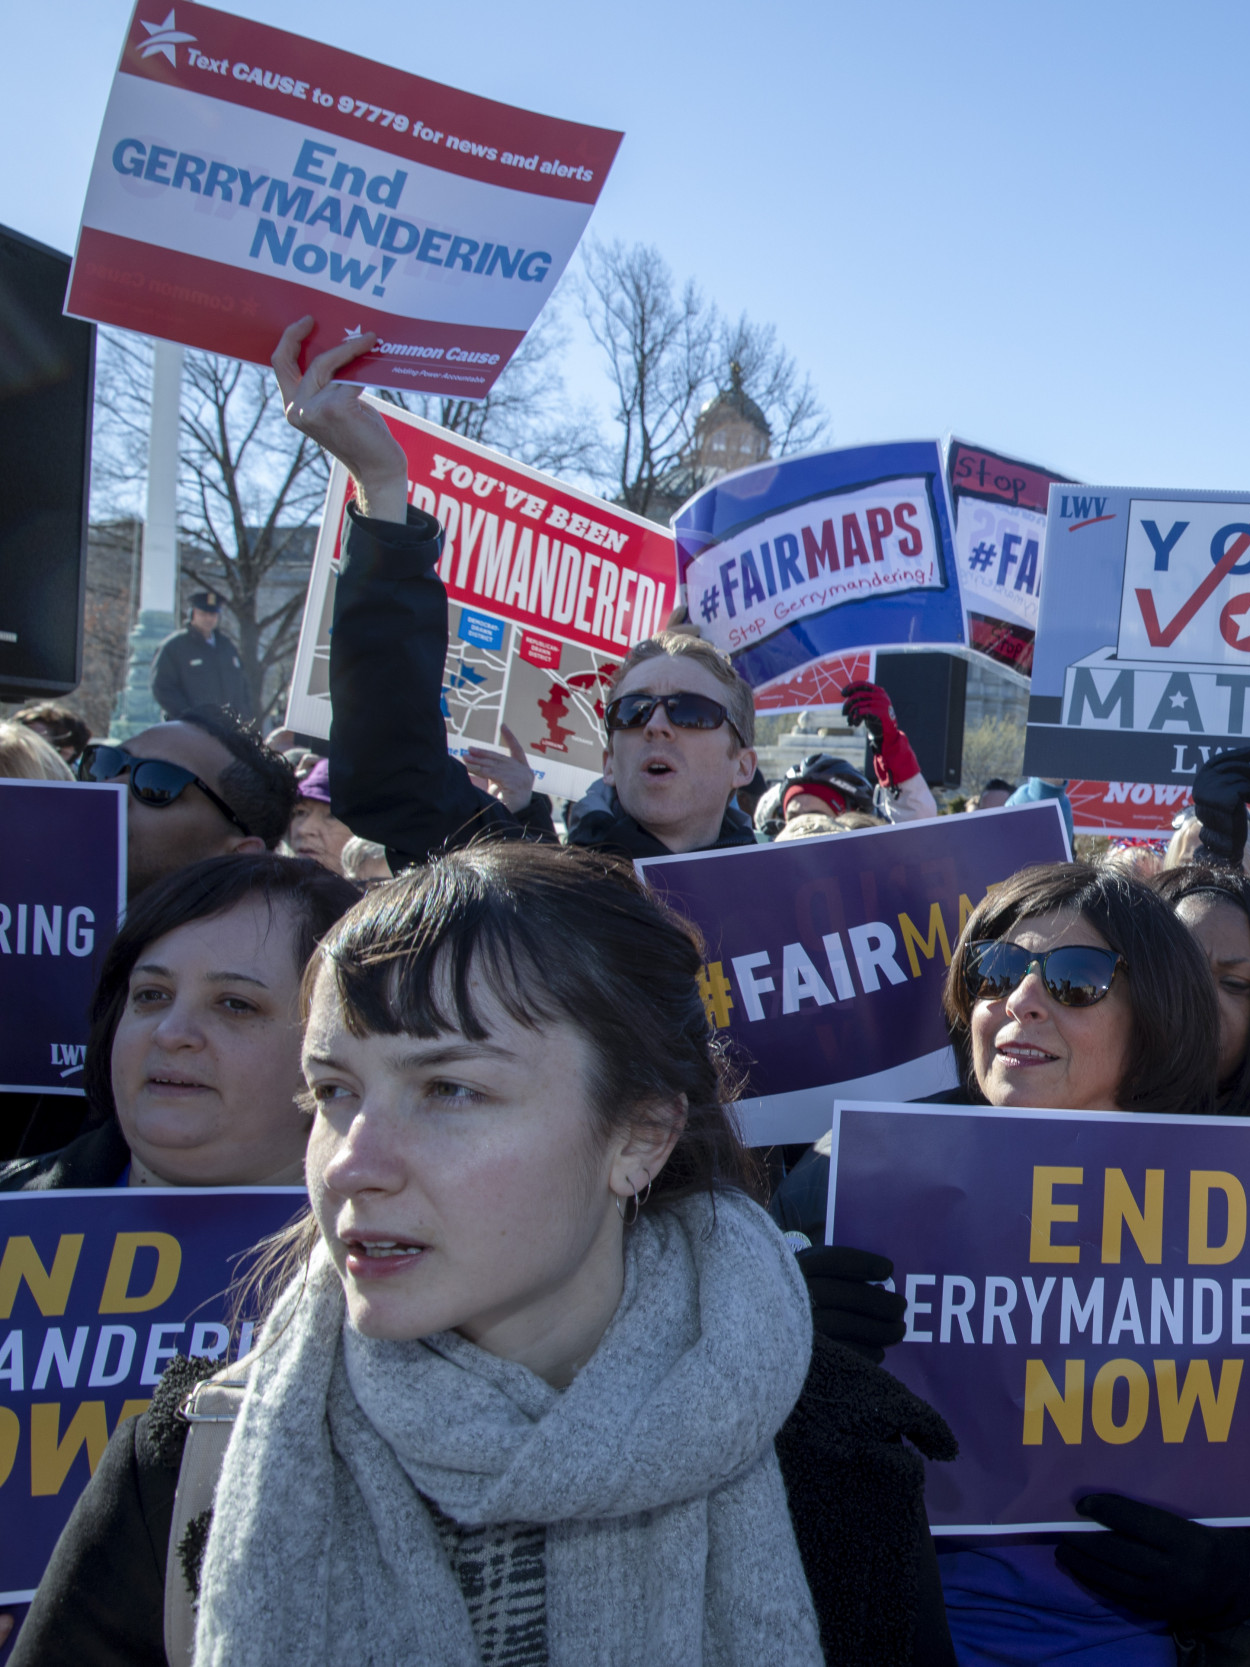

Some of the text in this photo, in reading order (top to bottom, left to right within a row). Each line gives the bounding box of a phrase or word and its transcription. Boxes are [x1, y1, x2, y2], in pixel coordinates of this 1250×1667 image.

[188, 47, 594, 182] Text CAUSE to 97779 for news and alerts
[111, 137, 552, 284] GERRYMANDERING
[292, 138, 409, 210] End
[248, 218, 397, 297] Now!
[371, 338, 501, 365] Common Cause
[430, 453, 630, 554] YOU'VE BEEN
[1059, 495, 1108, 520] LWV
[407, 480, 666, 650] RYMANDERED!
[699, 502, 923, 623] #FAIRMAPS
[729, 562, 935, 650] Stop Gerrymandering!
[968, 532, 1042, 598] #FA
[1102, 781, 1193, 806] NOW!
[695, 881, 1003, 1029] #FAIRM
[1029, 1165, 1248, 1266] END
[1022, 1357, 1245, 1446] NOW
